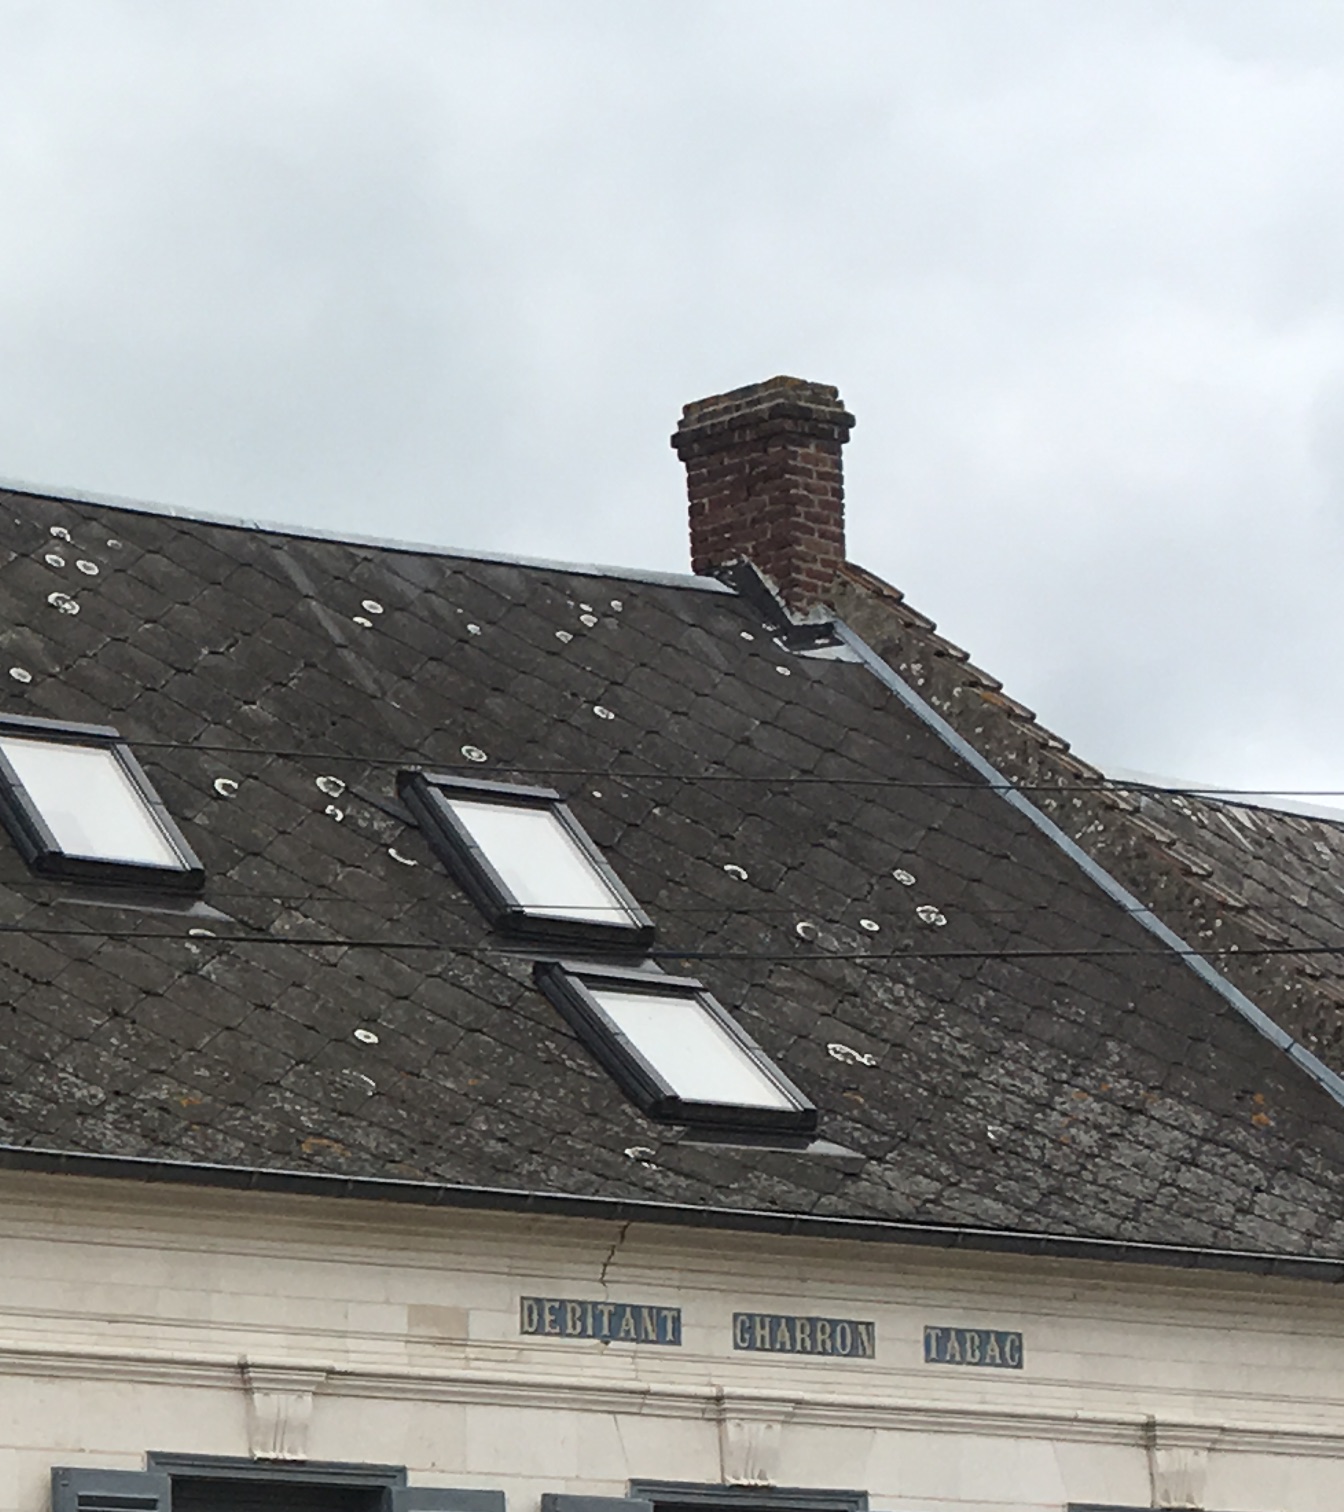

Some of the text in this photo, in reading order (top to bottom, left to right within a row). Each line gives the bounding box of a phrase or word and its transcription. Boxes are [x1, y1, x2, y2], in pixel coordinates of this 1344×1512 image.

[522, 1299, 1020, 1367] DEBITANT CHARRON TABAC
